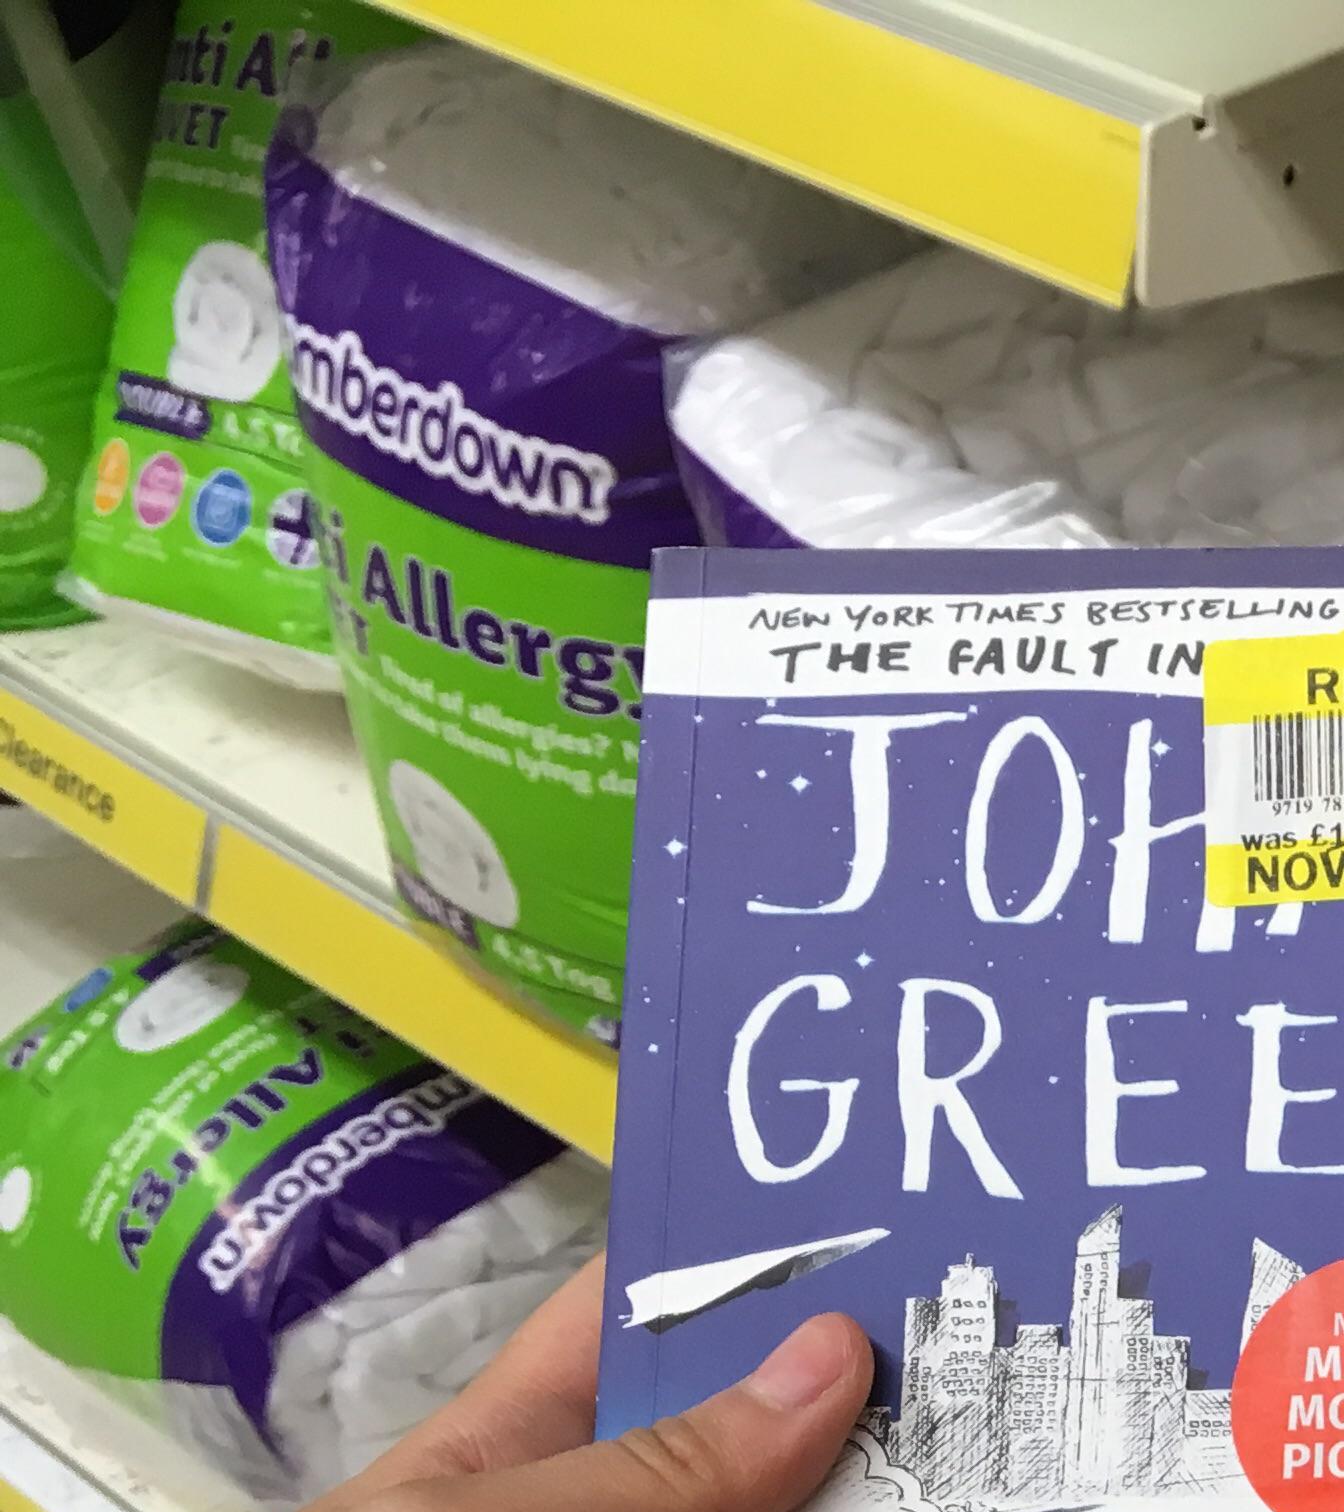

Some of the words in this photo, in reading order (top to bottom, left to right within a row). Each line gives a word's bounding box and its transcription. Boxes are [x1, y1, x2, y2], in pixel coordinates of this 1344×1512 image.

[748, 607, 830, 630] NEW
[845, 605, 934, 631] YORK
[945, 600, 1065, 624] TIMES
[1087, 598, 1340, 625] BESTSELLING
[770, 641, 911, 683] THE
[948, 636, 1119, 677] FAULT
[1147, 640, 1205, 677] IN
[1273, 800, 1313, 816] 9719
[1241, 831, 1297, 851] was
